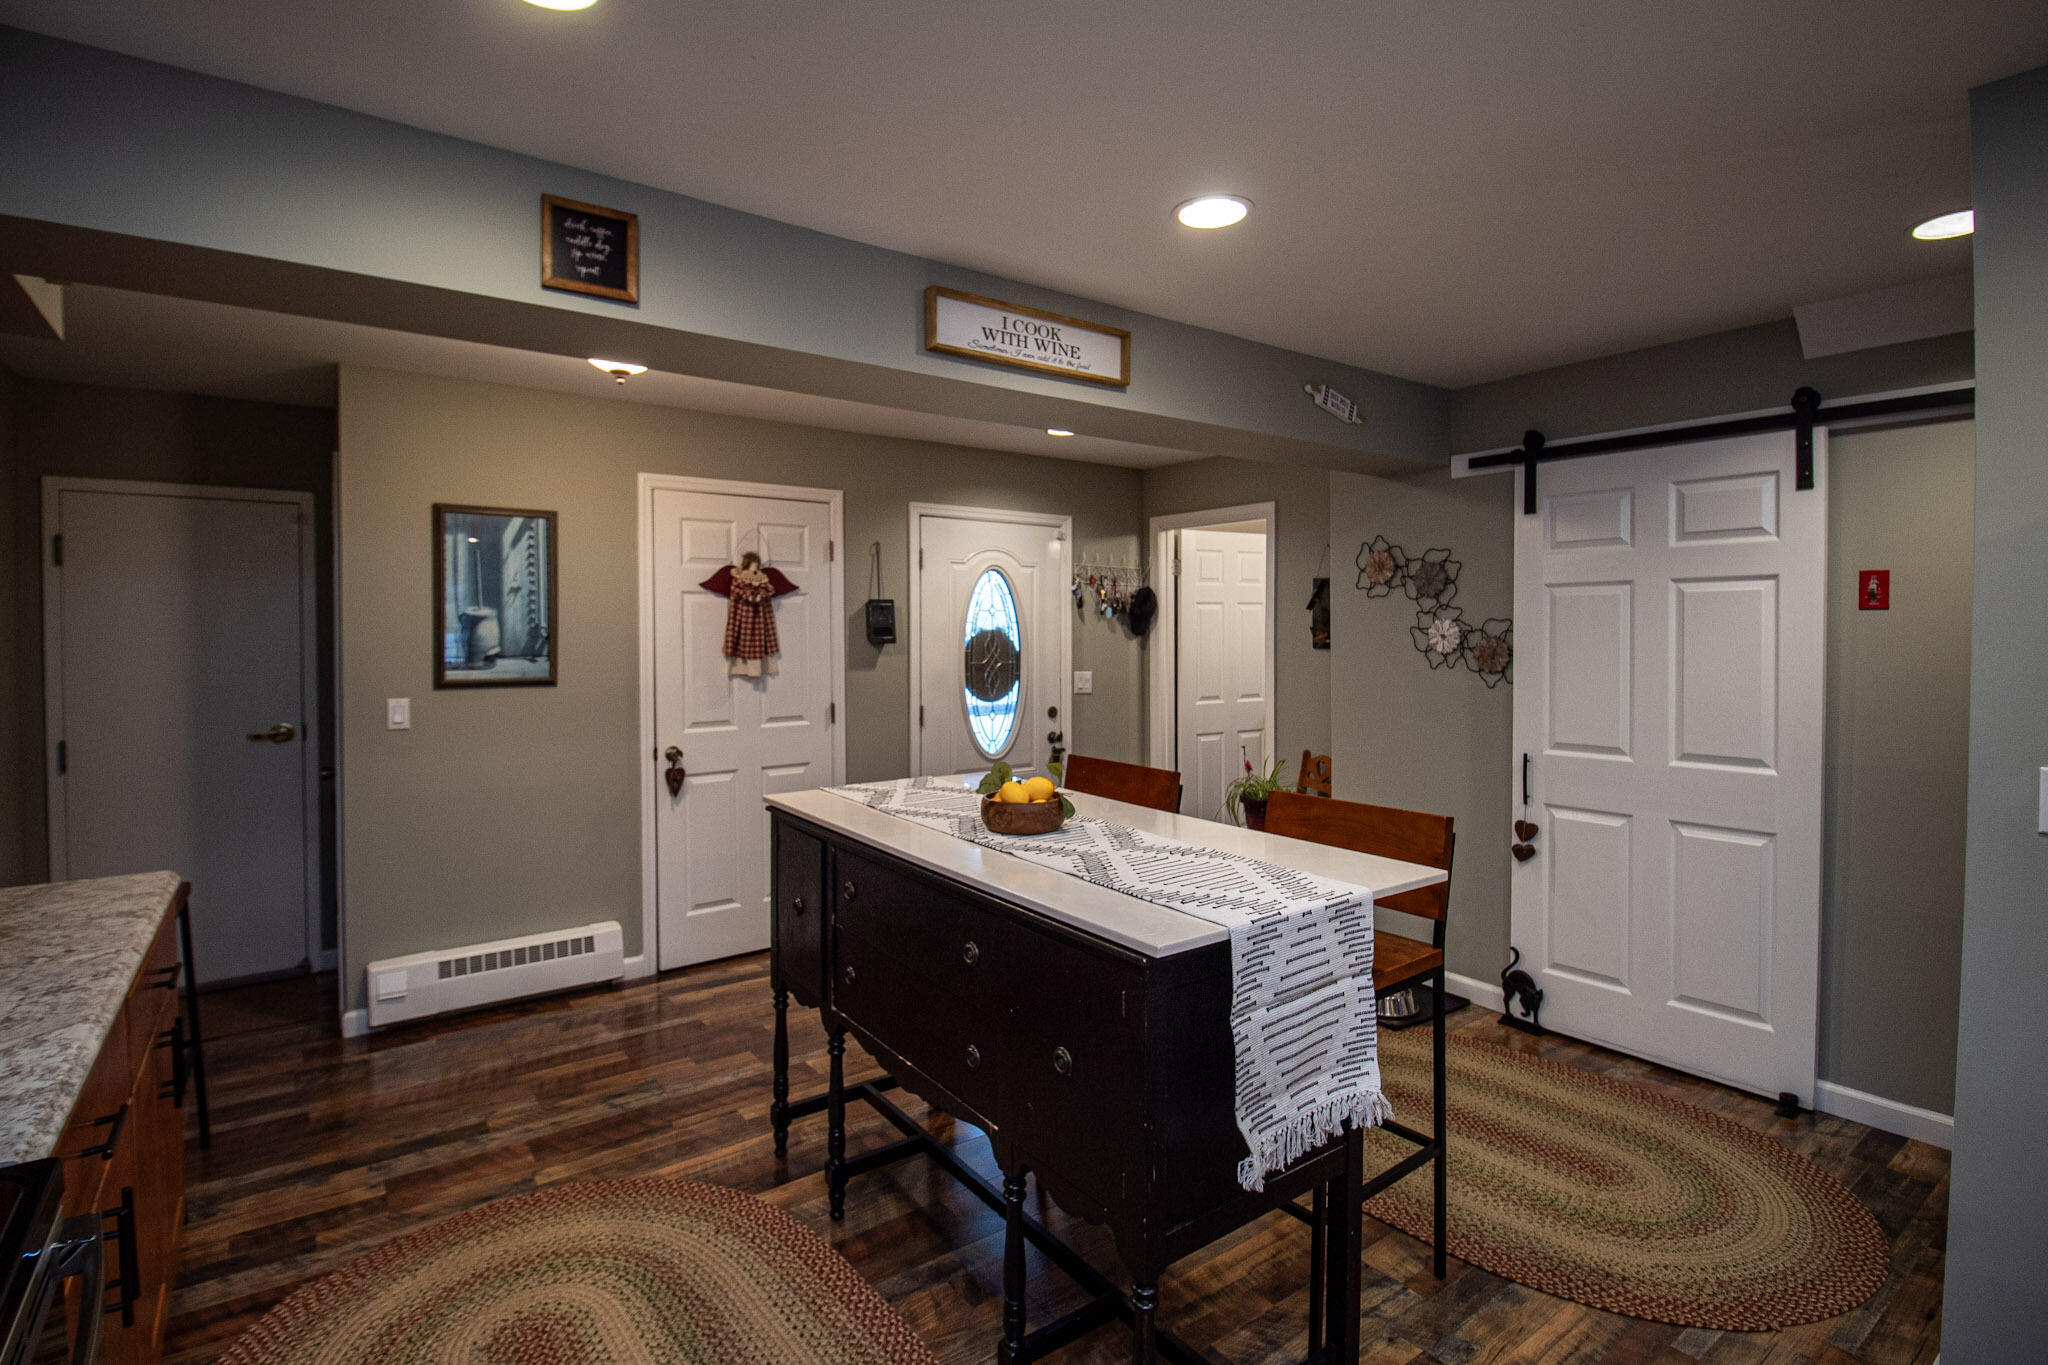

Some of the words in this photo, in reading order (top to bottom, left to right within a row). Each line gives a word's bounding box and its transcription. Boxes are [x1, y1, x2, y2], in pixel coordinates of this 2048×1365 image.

[1002, 316, 1008, 330] I
[1013, 319, 1062, 341] COOK
[981, 327, 1029, 348] WITH
[1034, 338, 1081, 360] WINE
